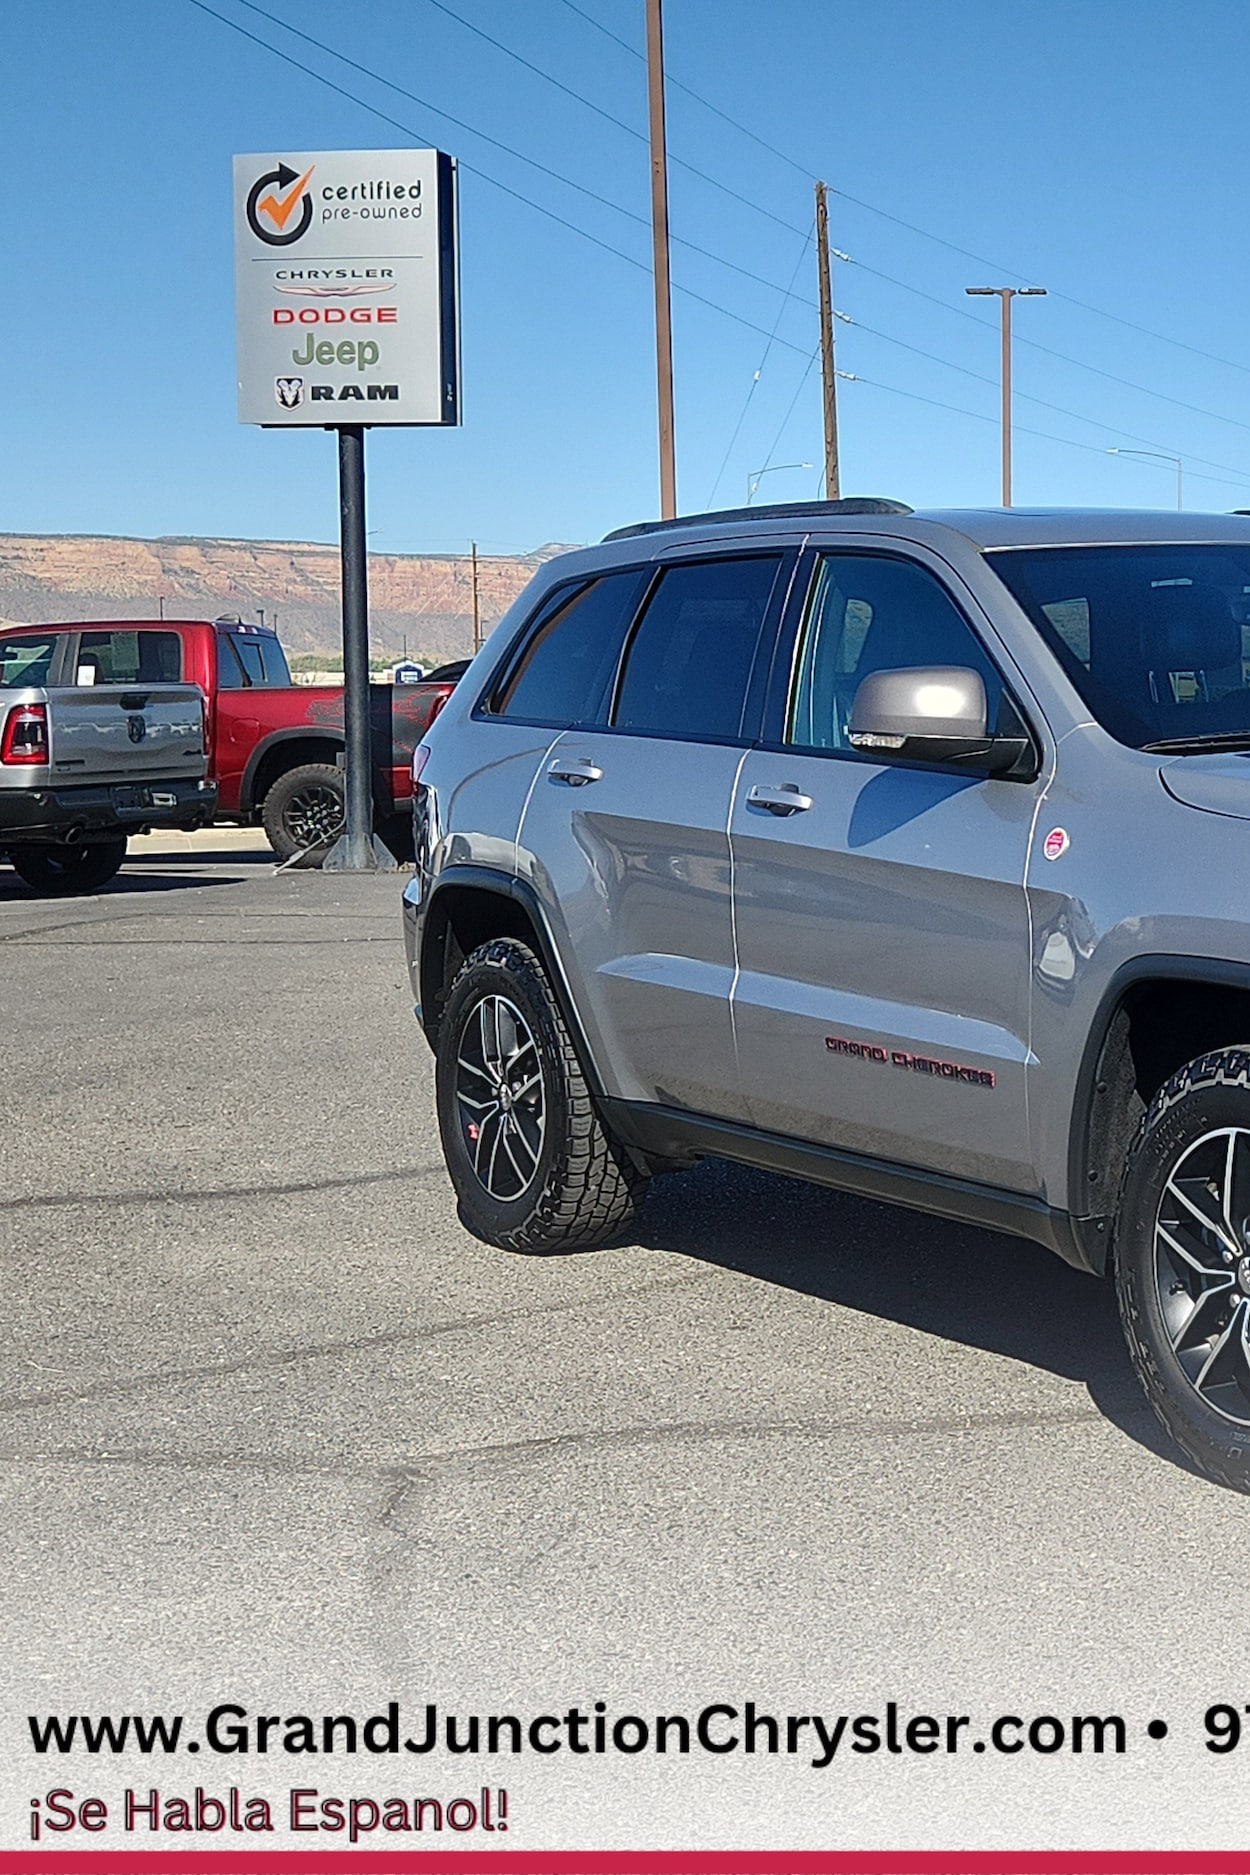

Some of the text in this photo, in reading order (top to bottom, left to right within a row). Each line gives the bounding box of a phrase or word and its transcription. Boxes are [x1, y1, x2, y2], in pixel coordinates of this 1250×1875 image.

[322, 179, 422, 201] certified
[322, 203, 422, 224] pre-owned
[275, 268, 394, 280] CHRYSLER
[273, 308, 398, 324] DODGE
[292, 332, 379, 371] Jeep
[311, 385, 399, 401] RAM
[825, 1036, 888, 1063] GRAND
